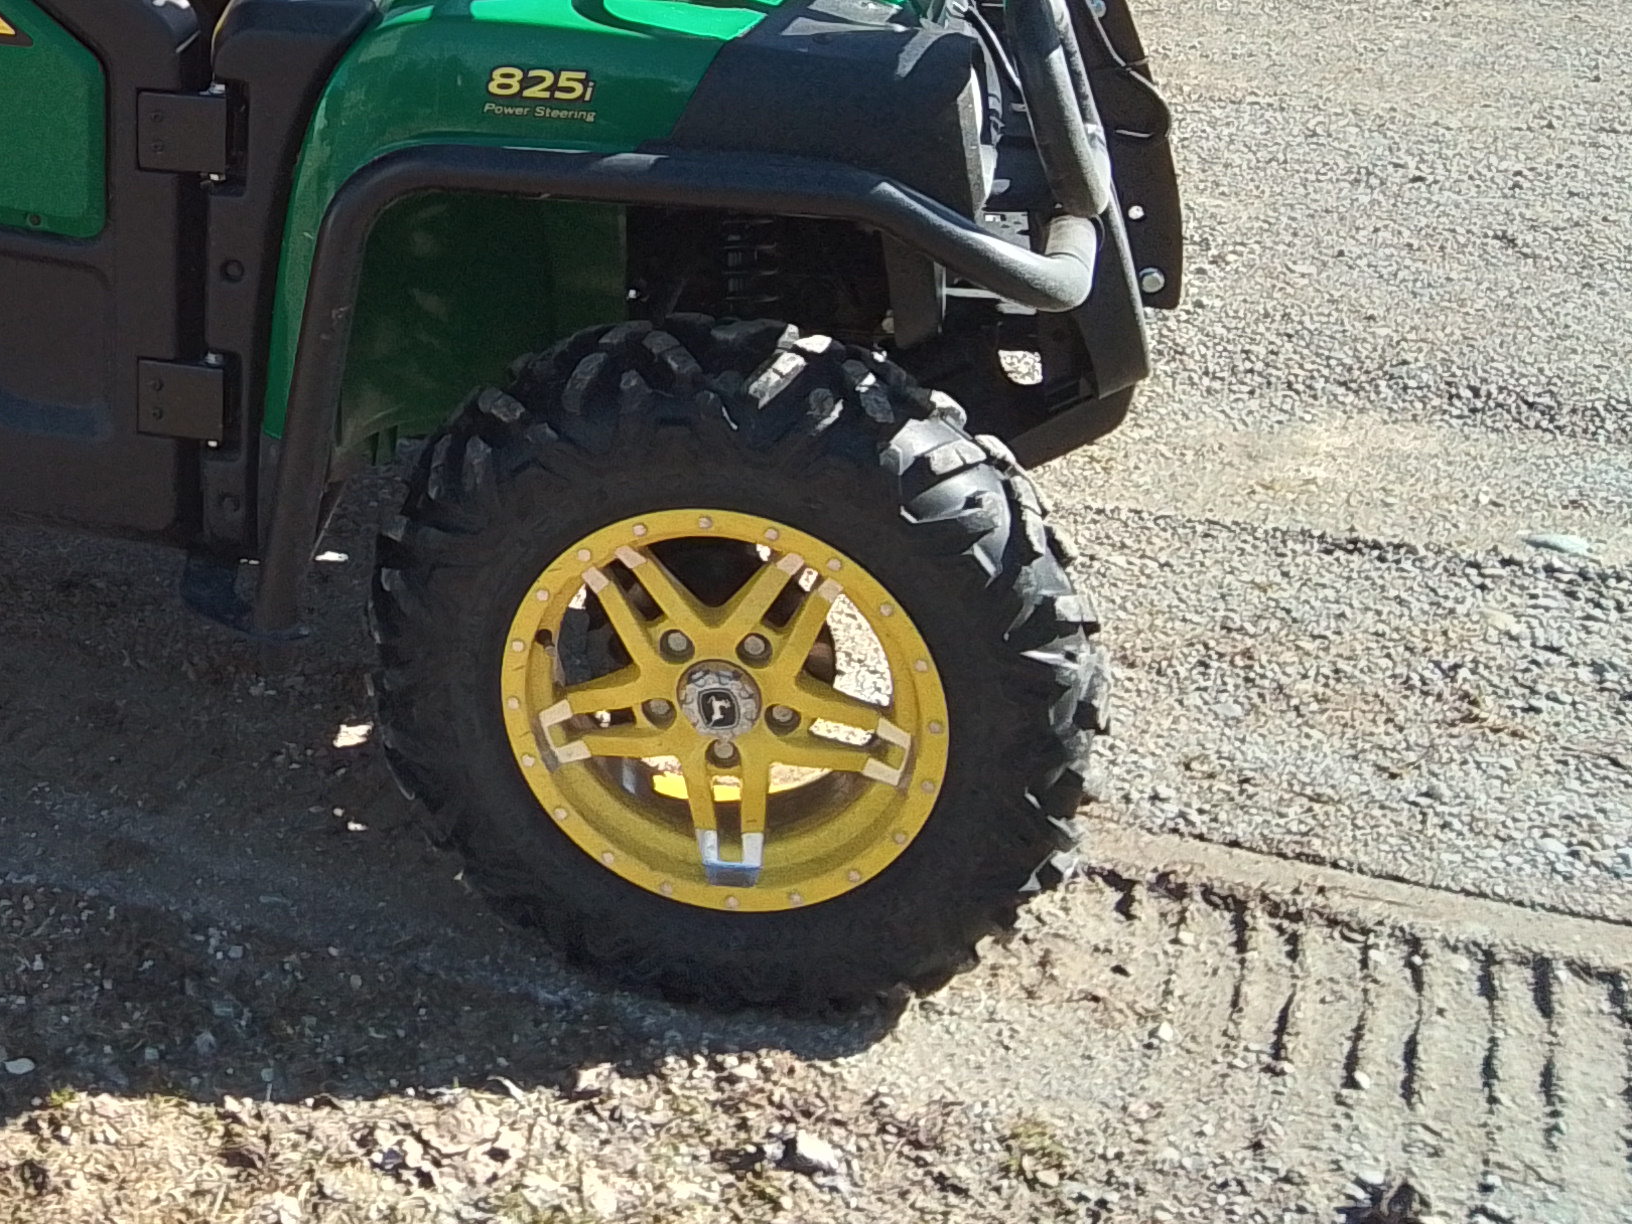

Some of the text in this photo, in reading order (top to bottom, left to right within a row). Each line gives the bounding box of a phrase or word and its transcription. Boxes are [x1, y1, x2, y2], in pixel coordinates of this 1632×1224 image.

[487, 66, 595, 102] 825i
[483, 102, 597, 123] Power Steering
